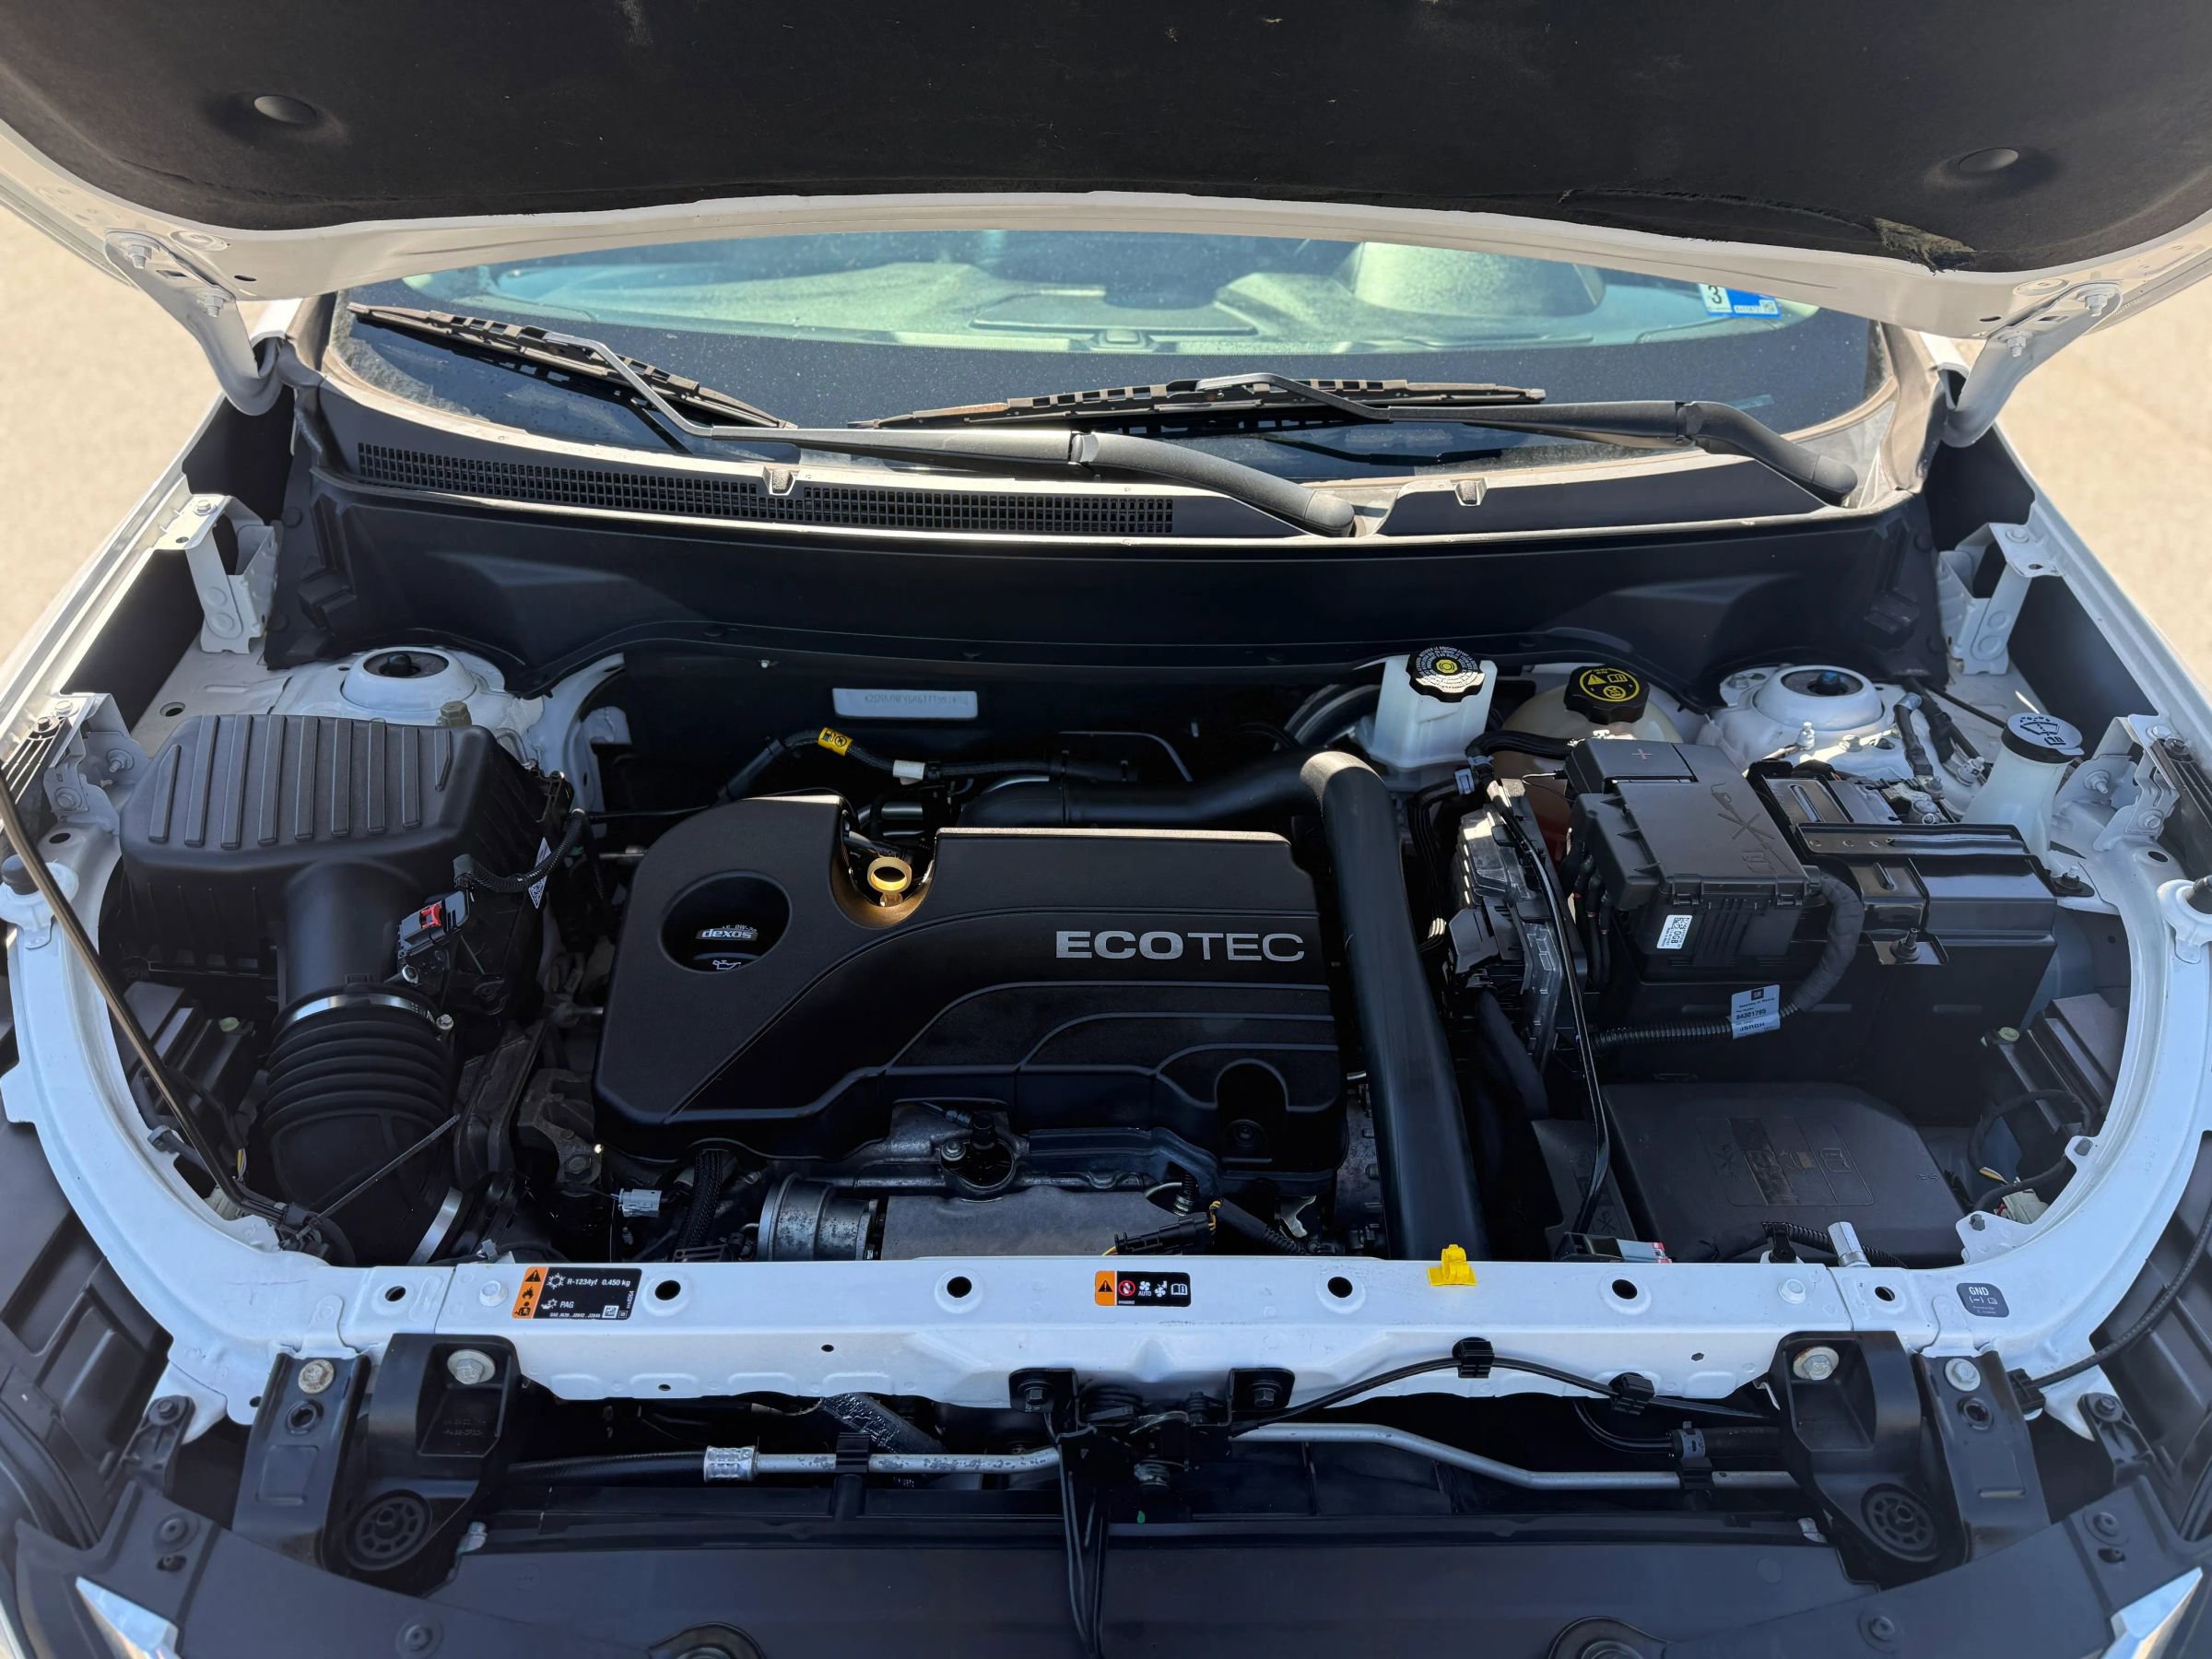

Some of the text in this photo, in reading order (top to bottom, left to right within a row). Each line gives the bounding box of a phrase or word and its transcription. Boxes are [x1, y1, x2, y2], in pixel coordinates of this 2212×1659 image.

[701, 928, 752, 938] dexos
[1056, 930, 1305, 962] ECOTEC
[621, 1279, 630, 1288] kg
[1969, 1286, 1989, 1296] GND
[559, 1300, 574, 1309] PAG
